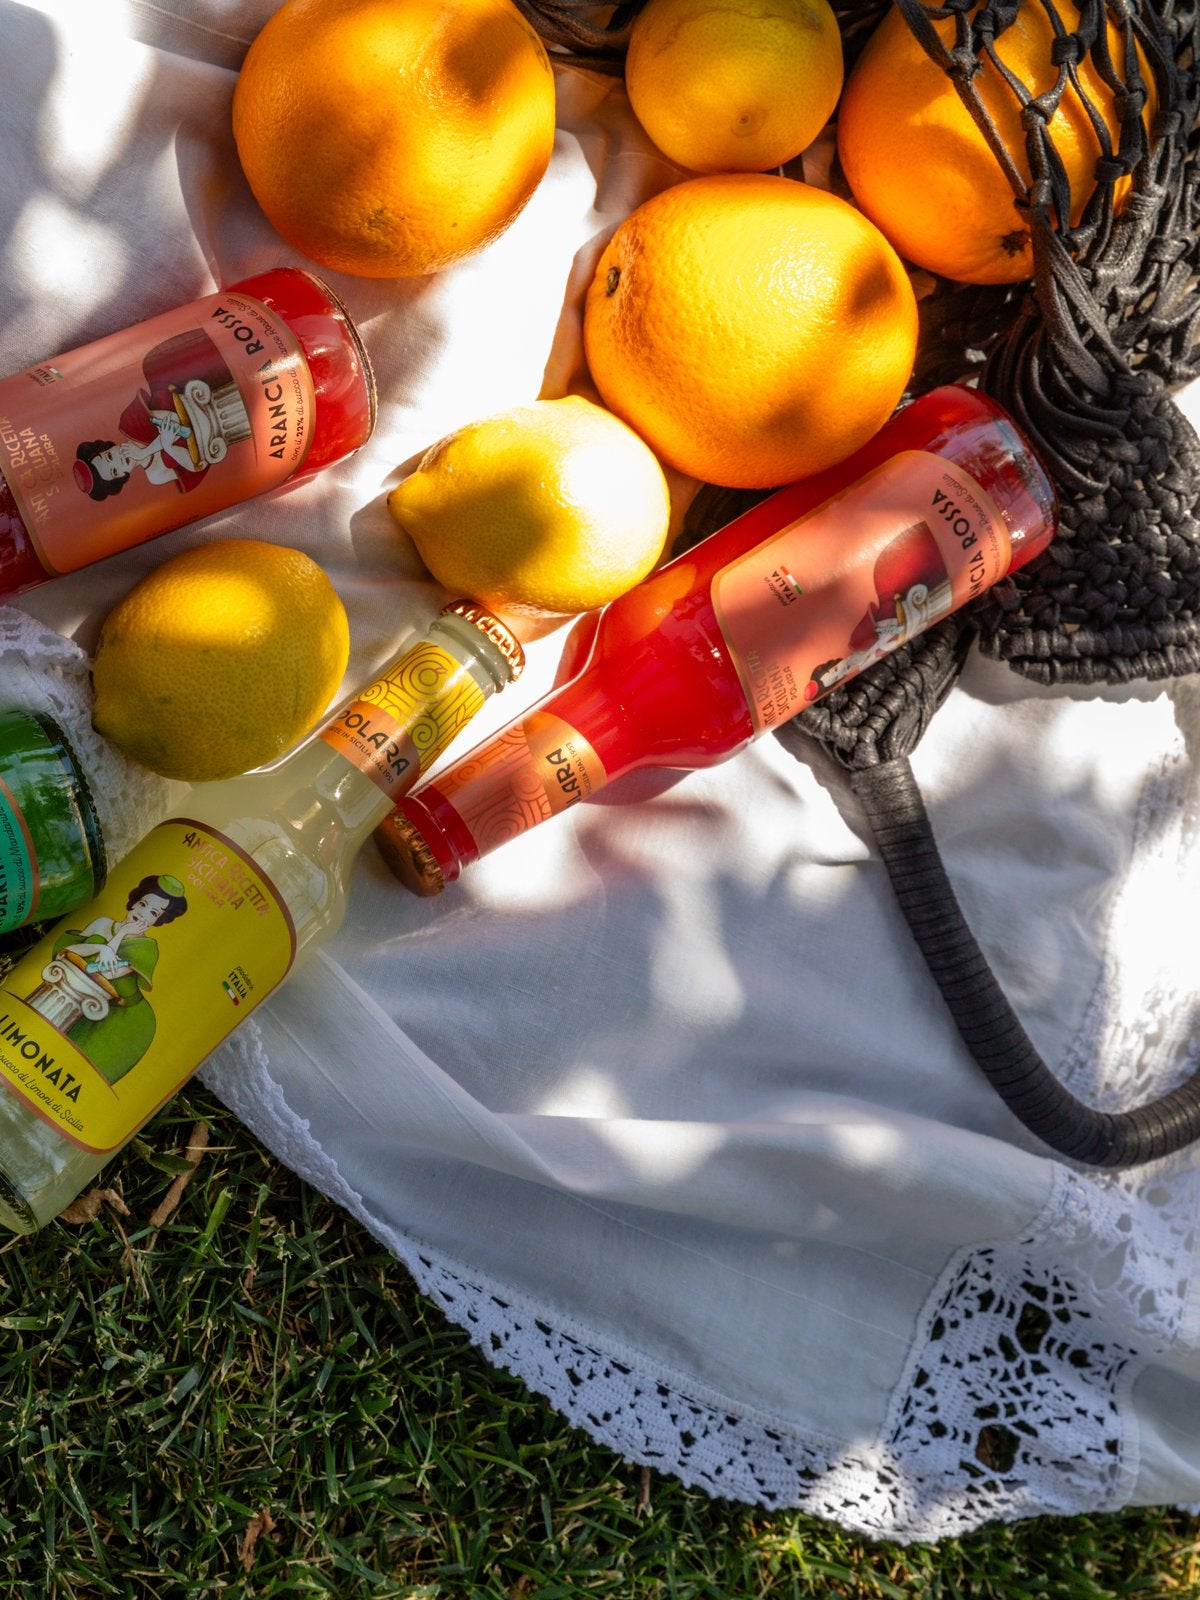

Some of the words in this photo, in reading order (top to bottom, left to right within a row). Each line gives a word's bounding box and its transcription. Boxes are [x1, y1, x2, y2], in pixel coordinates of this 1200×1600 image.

[211, 307, 264, 356] ROSSA
[256, 359, 287, 459] ARANCIA
[293, 378, 304, 406] succo
[296, 404, 304, 417] di
[296, 417, 304, 438] 22%
[19, 426, 60, 497] SICILIANA
[291, 447, 300, 461] con
[20, 468, 50, 526] ANTICA
[931, 488, 978, 550] ROSSA
[772, 570, 797, 604] ITALIA
[746, 649, 770, 704] RICETTA
[767, 662, 790, 716] SICILIANA
[783, 665, 798, 701] POLARA
[349, 736, 372, 758] SICILIA
[372, 754, 384, 770] DAL
[566, 742, 578, 758] 1953
[546, 747, 582, 806] LARA
[12, 856, 23, 868] di
[182, 832, 230, 870] ANTICA
[228, 862, 272, 918] RICETTA
[188, 854, 244, 911] SICILIANA
[228, 971, 248, 1000] ITALIA
[18, 1070, 28, 1082] di
[24, 1079, 54, 1106] Limoni
[52, 1103, 62, 1114] di
[60, 1110, 84, 1132] Sicilia
